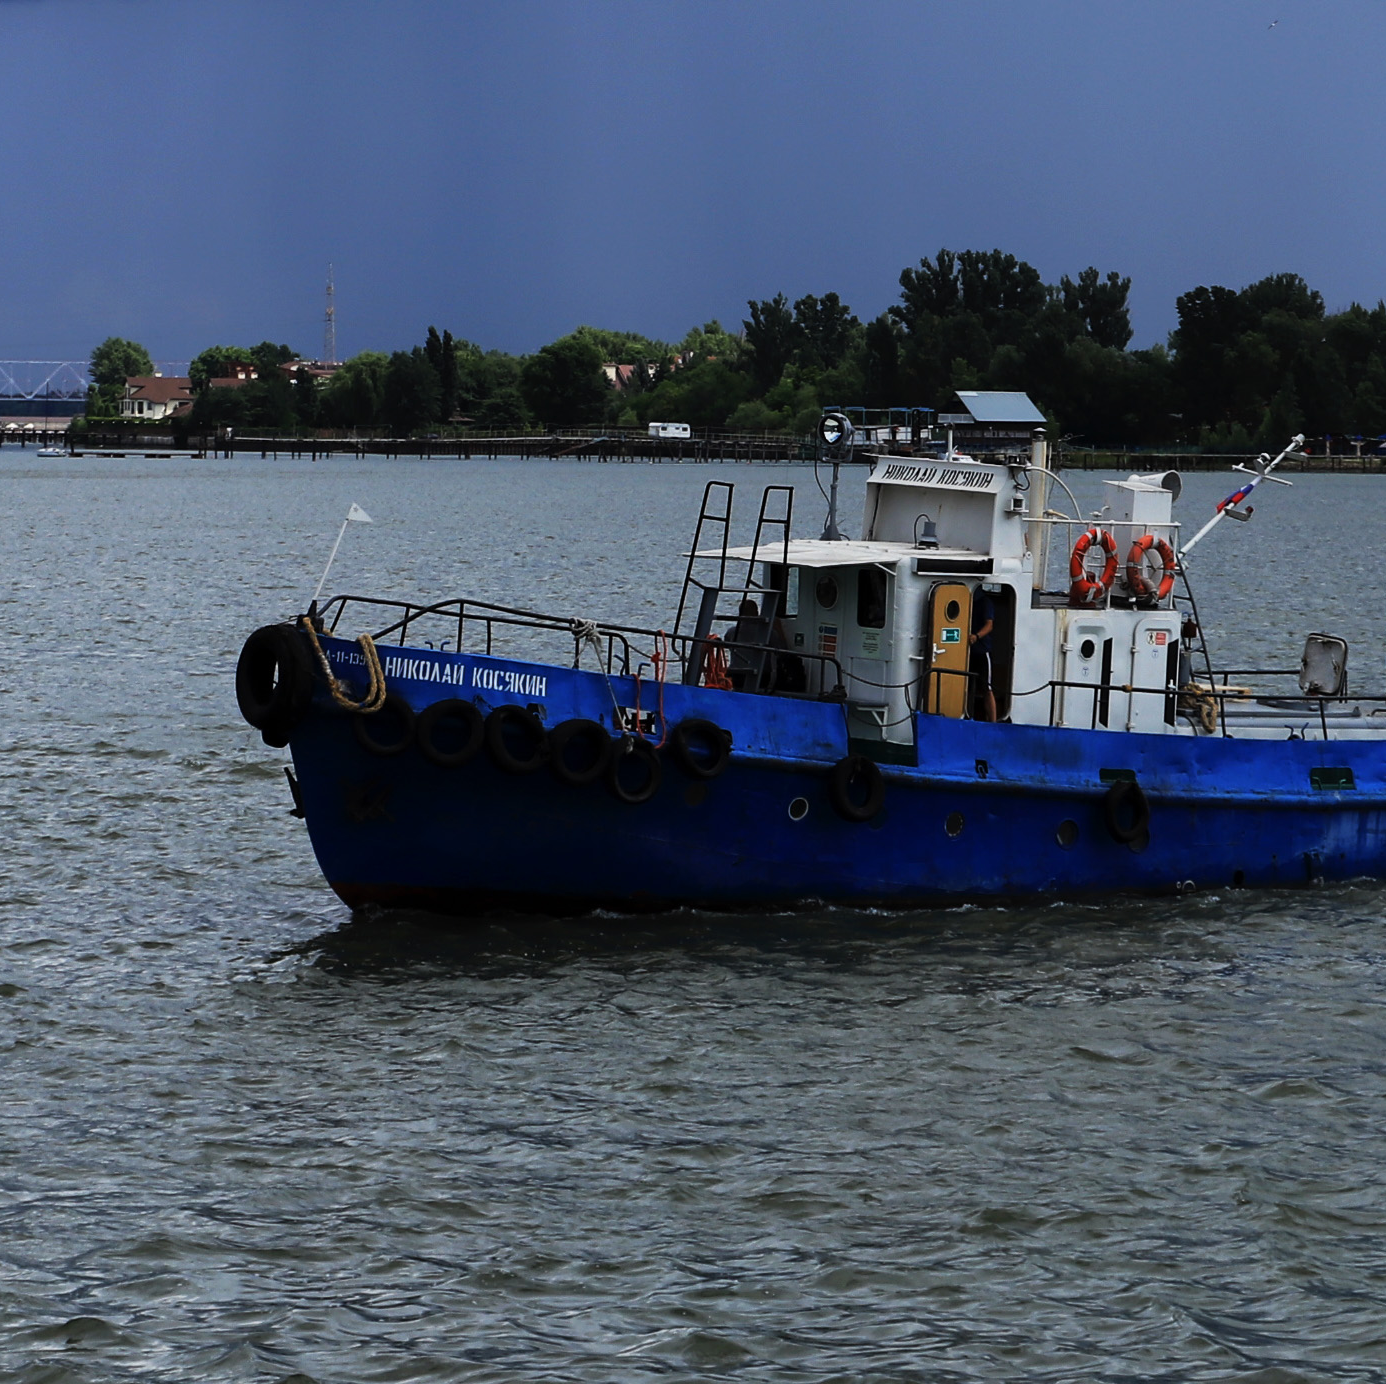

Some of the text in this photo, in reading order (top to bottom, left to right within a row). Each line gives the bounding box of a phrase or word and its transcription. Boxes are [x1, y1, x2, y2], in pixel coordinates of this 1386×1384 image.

[881, 464, 994, 488] НИКОЛАЙ КОСЯКИН
[385, 655, 547, 697] НИКОЛАЙ КОСЯКИН
